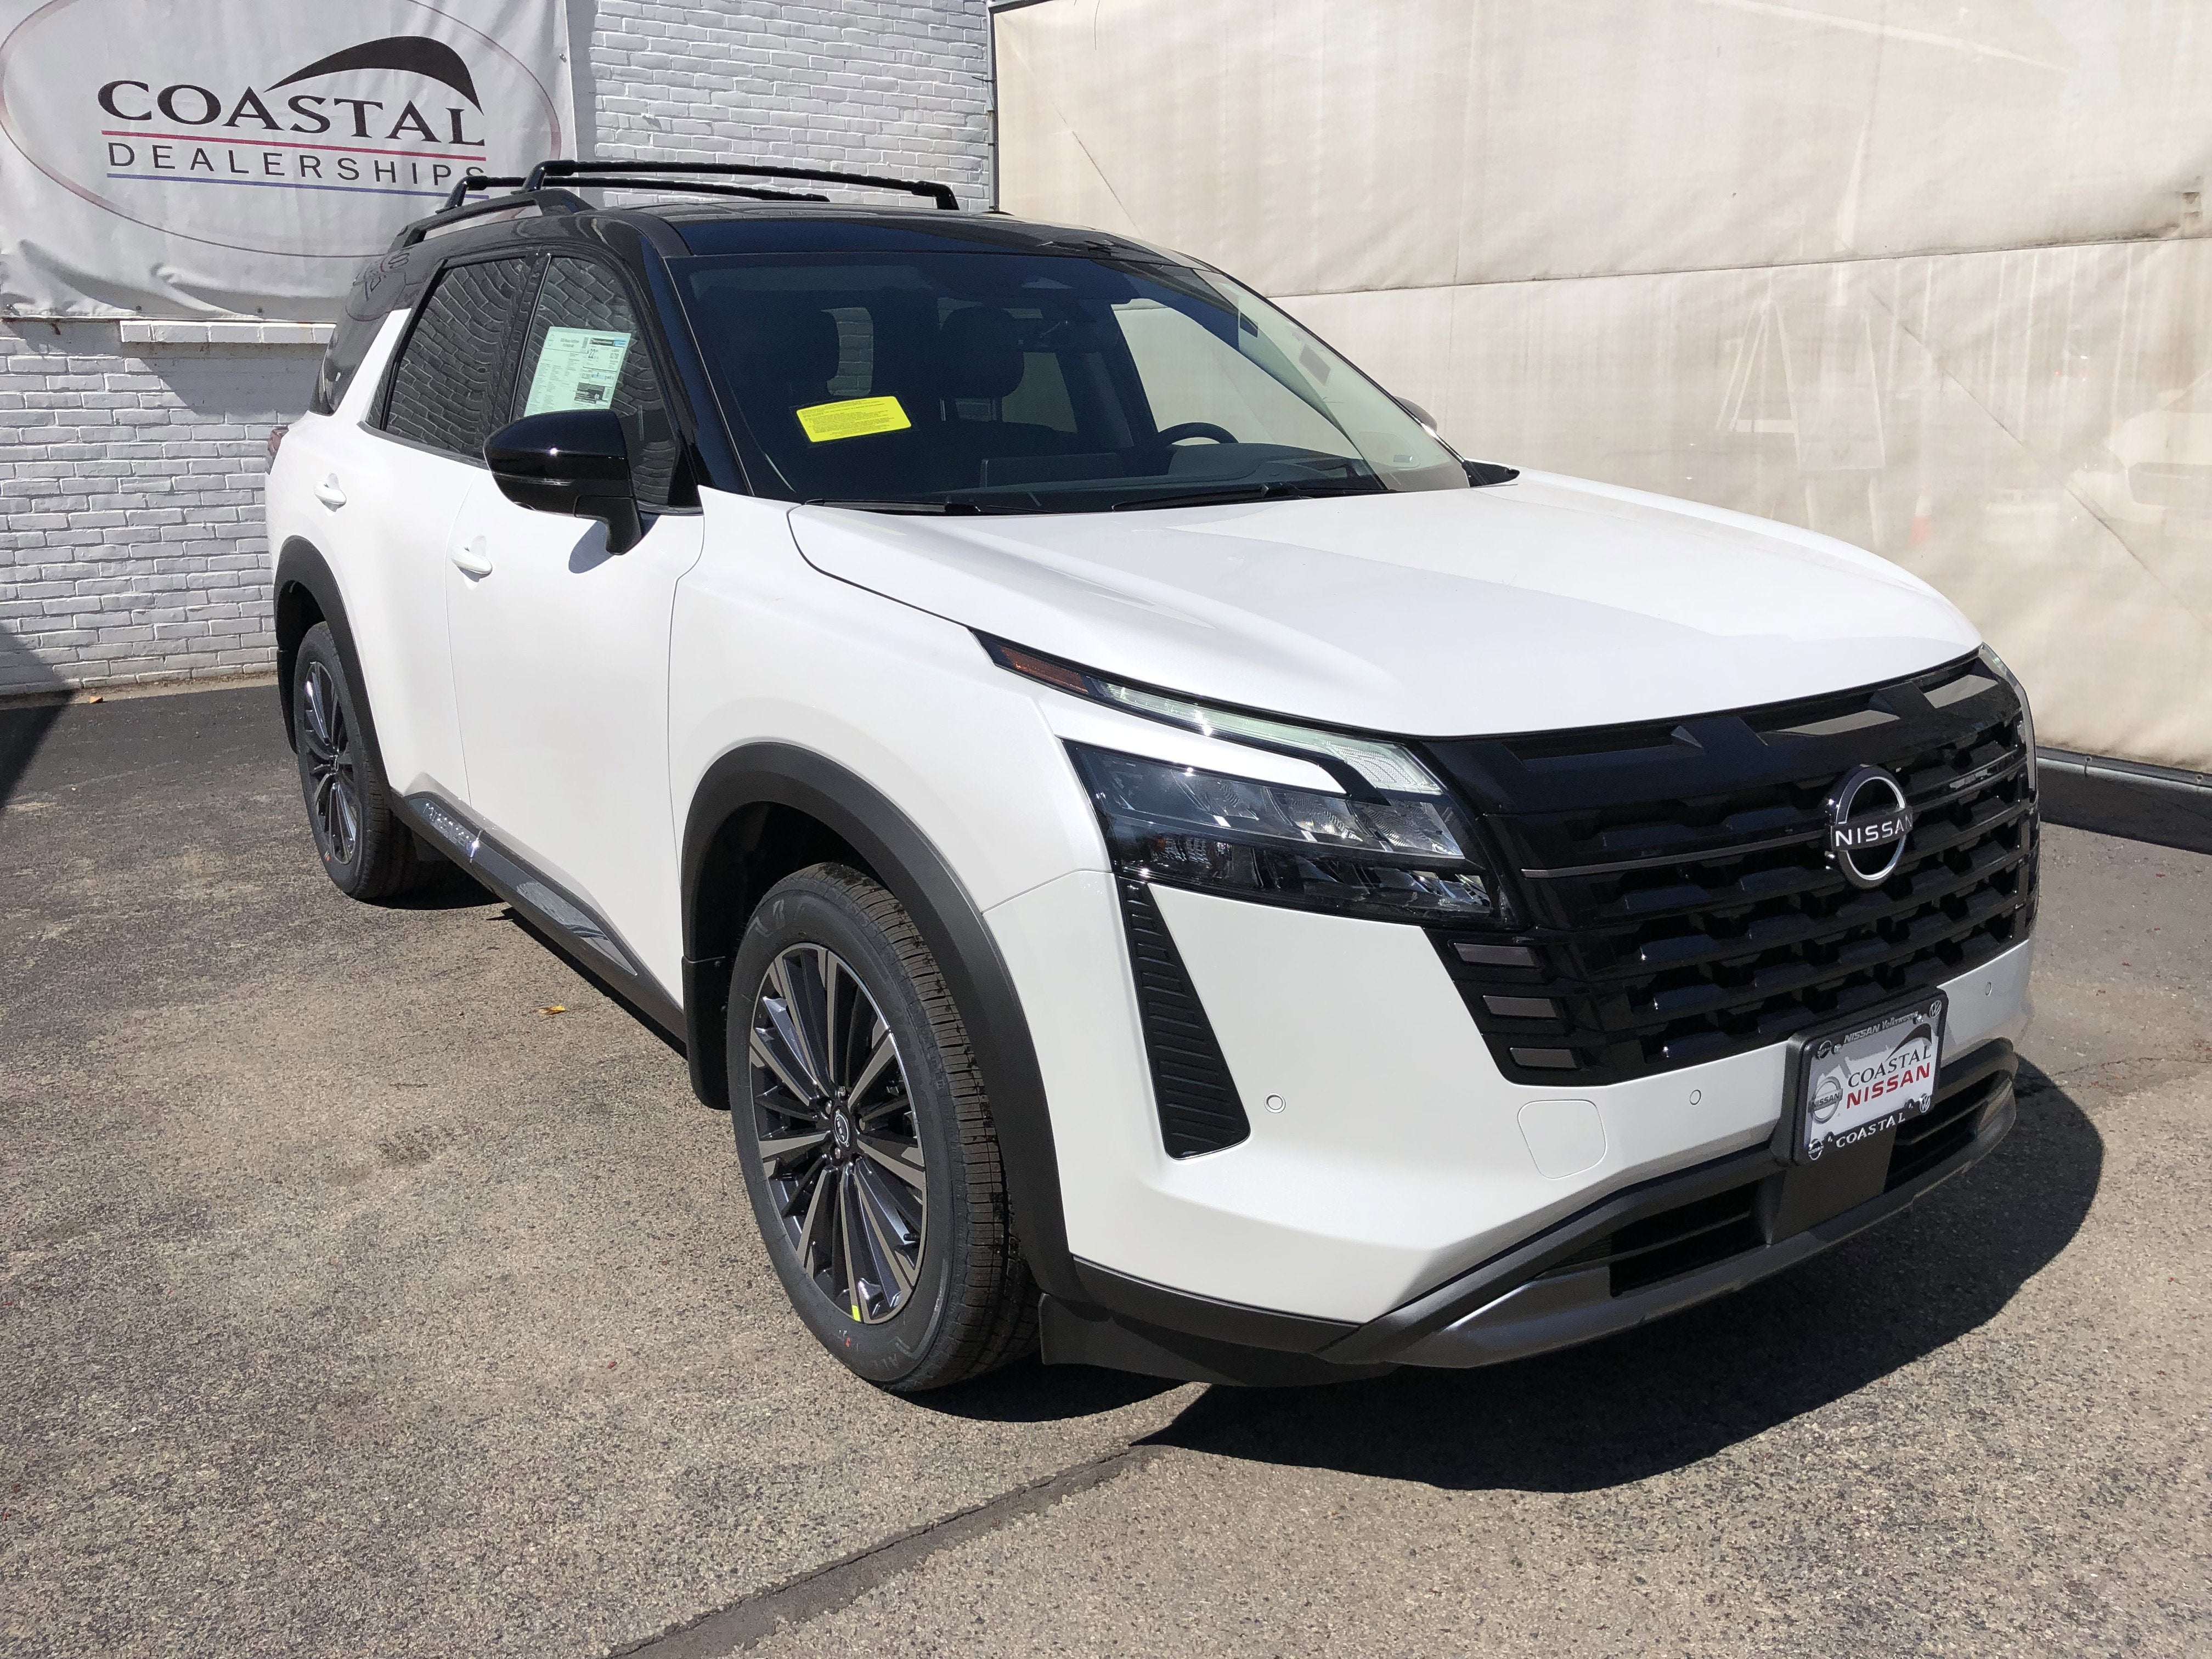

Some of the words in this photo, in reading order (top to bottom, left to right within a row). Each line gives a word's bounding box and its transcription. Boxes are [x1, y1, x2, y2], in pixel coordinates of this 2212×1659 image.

[98, 80, 486, 147] COASTAL
[1835, 812, 1913, 847] NISSAN
[1843, 1024, 1881, 1044] NISSAN
[1848, 1045, 1932, 1088] COASTAL
[1812, 1092, 1840, 1108] NISSAN
[1847, 1062, 1931, 1109] NISSAN
[1836, 1112, 1906, 1148] COASTAL
